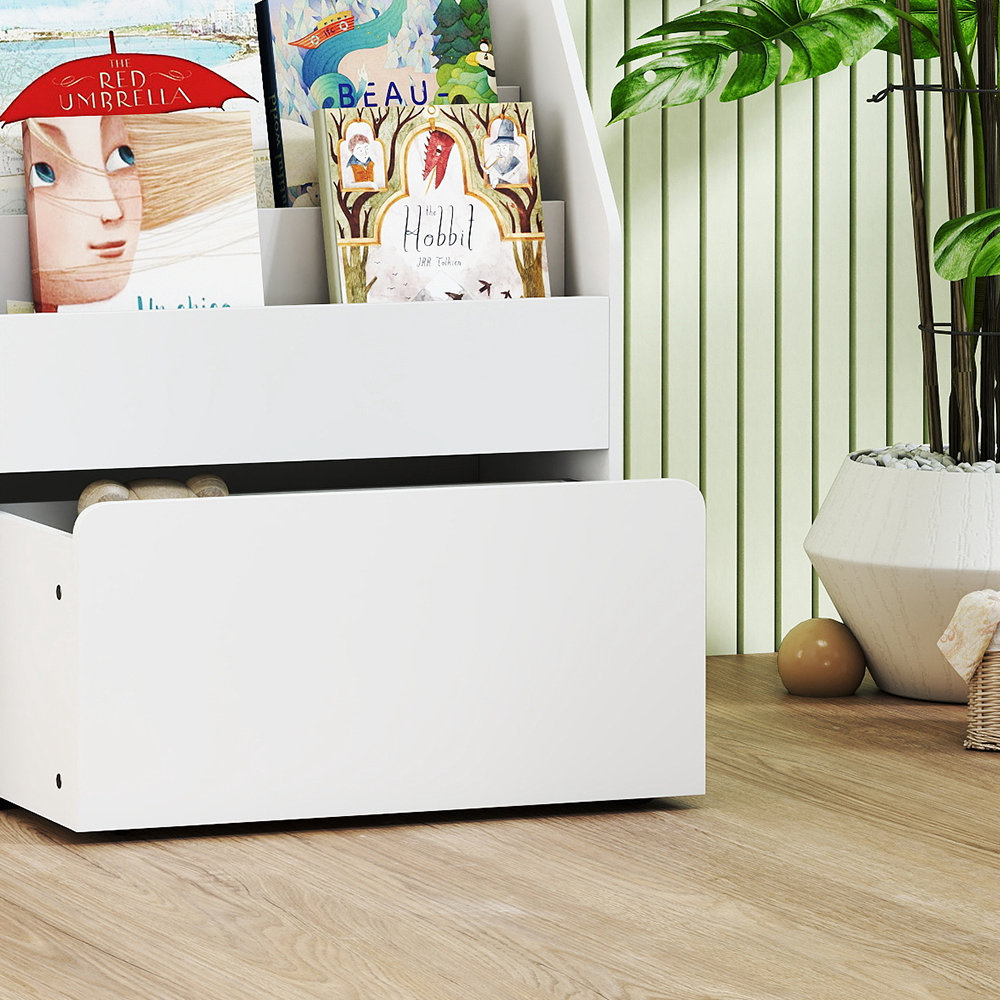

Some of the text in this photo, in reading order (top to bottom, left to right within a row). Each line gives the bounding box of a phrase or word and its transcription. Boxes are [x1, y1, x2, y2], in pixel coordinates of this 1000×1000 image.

[110, 58, 130, 68] THE
[99, 70, 146, 90] RED
[58, 87, 192, 112] UMBRELLA
[426, 205, 436, 216] the
[403, 204, 474, 252] Hobbit
